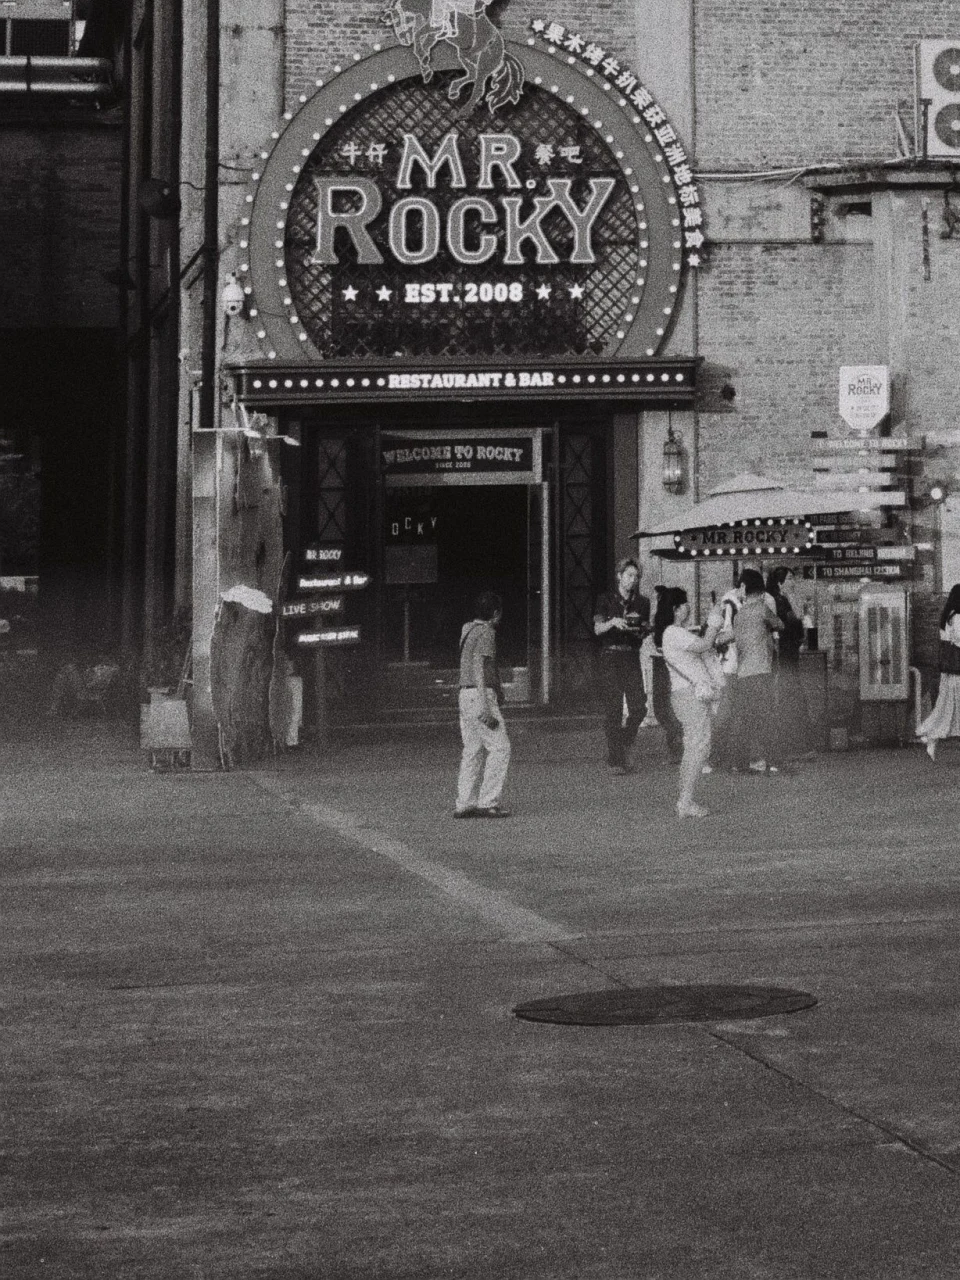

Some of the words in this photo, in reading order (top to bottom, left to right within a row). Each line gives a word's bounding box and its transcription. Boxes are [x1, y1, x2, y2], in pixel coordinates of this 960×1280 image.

[340, 141, 389, 166] 牛仔
[396, 133, 537, 189] MR.
[309, 176, 616, 265] ROCKY
[404, 282, 461, 303] EST.
[464, 282, 523, 303] 2008
[388, 372, 502, 389] RESTAURANT
[504, 372, 517, 388] &
[518, 371, 555, 388] BAR
[847, 382, 883, 396] ROCKY
[382, 445, 452, 464] WELCOME
[454, 445, 474, 460] TO
[476, 445, 524, 462] ROCKY
[733, 529, 789, 544] ROCKY
[832, 549, 842, 558] TO
[822, 567, 833, 577] TO
[834, 566, 872, 576] SHANGHAI
[282, 603, 307, 615] LIVE
[308, 599, 341, 612] SHOW
